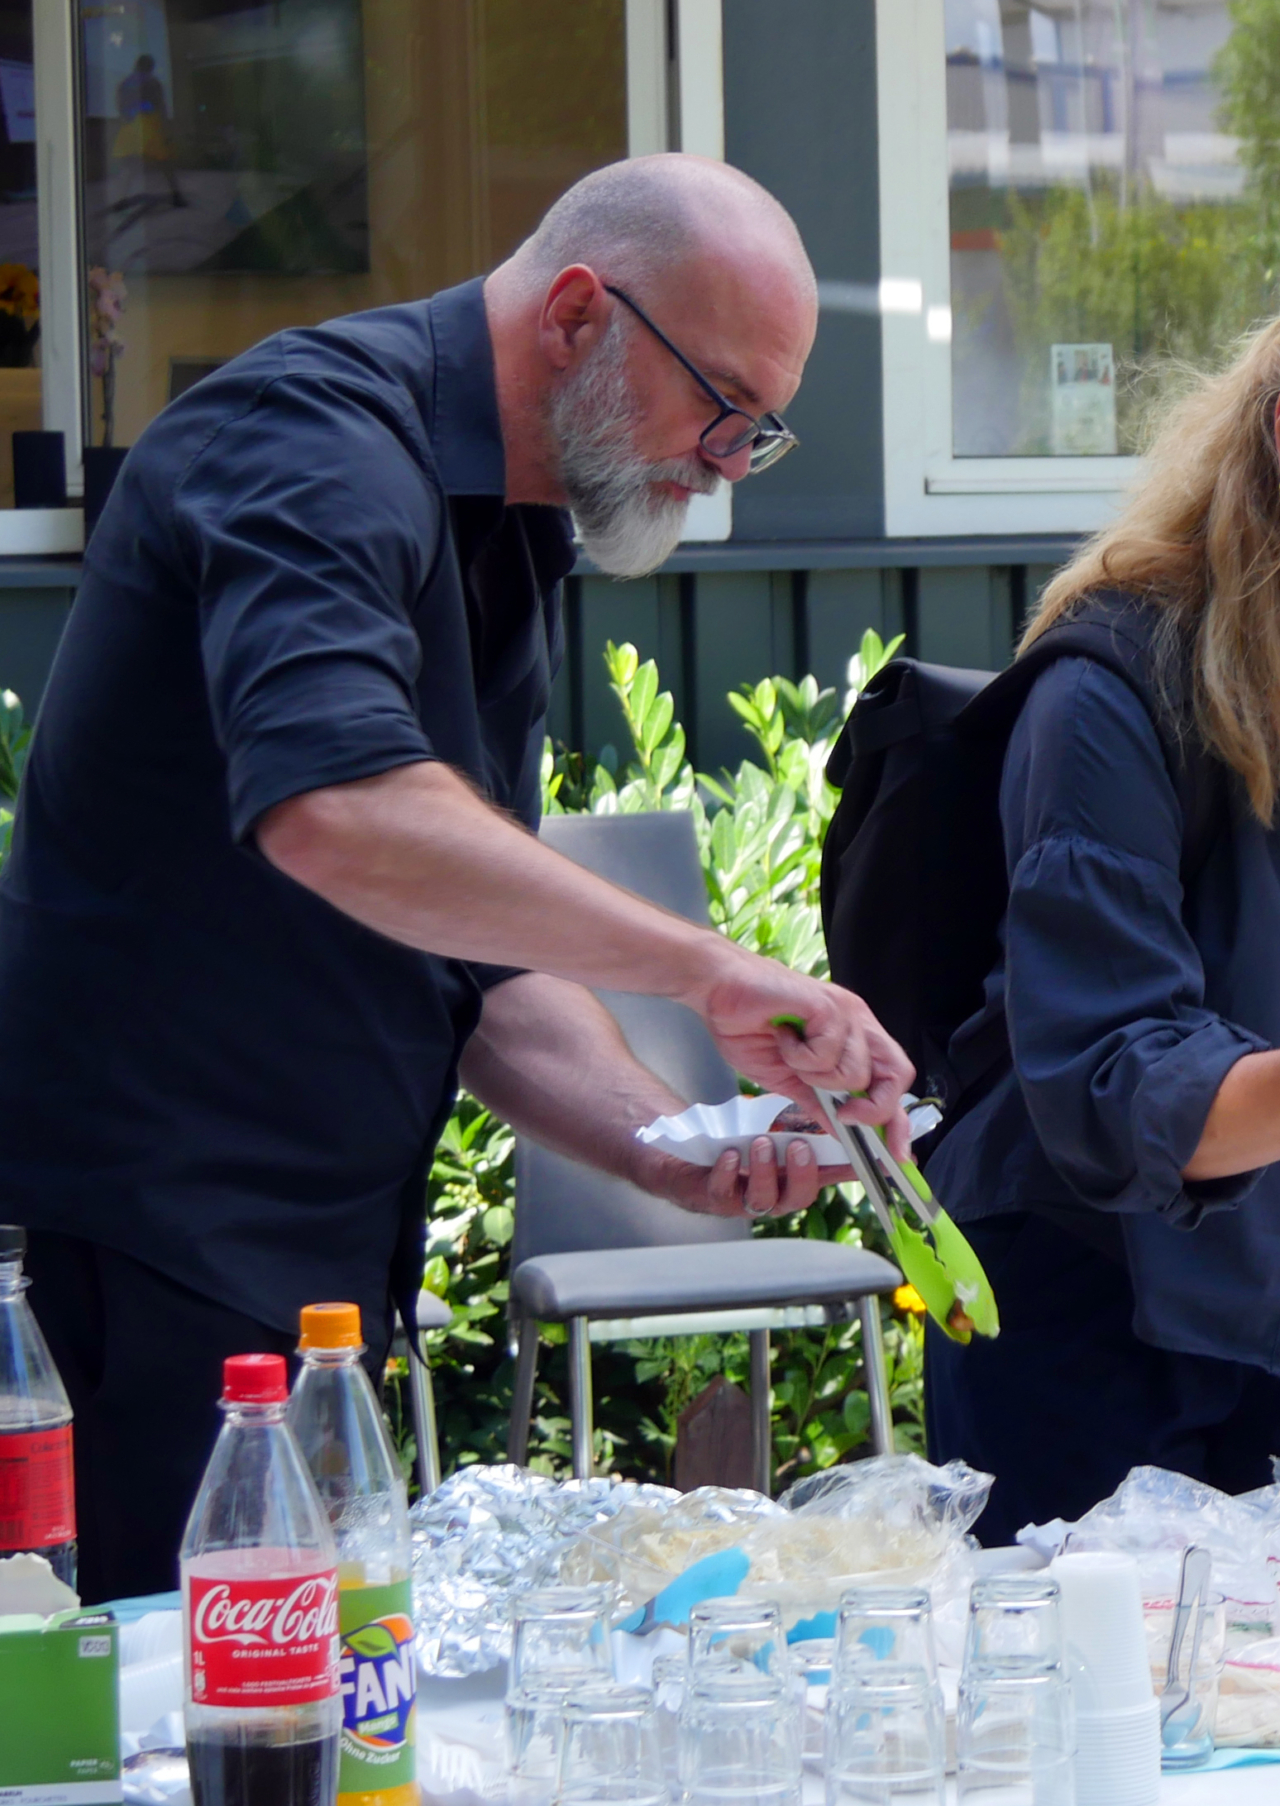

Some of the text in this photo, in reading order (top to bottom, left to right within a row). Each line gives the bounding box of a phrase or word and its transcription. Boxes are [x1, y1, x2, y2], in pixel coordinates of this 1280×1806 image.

[194, 1572, 339, 1646] Coca-Cola
[231, 1643, 320, 1659] ORIGINAL TASTE
[340, 1737, 401, 1765] Ohne Zucker
